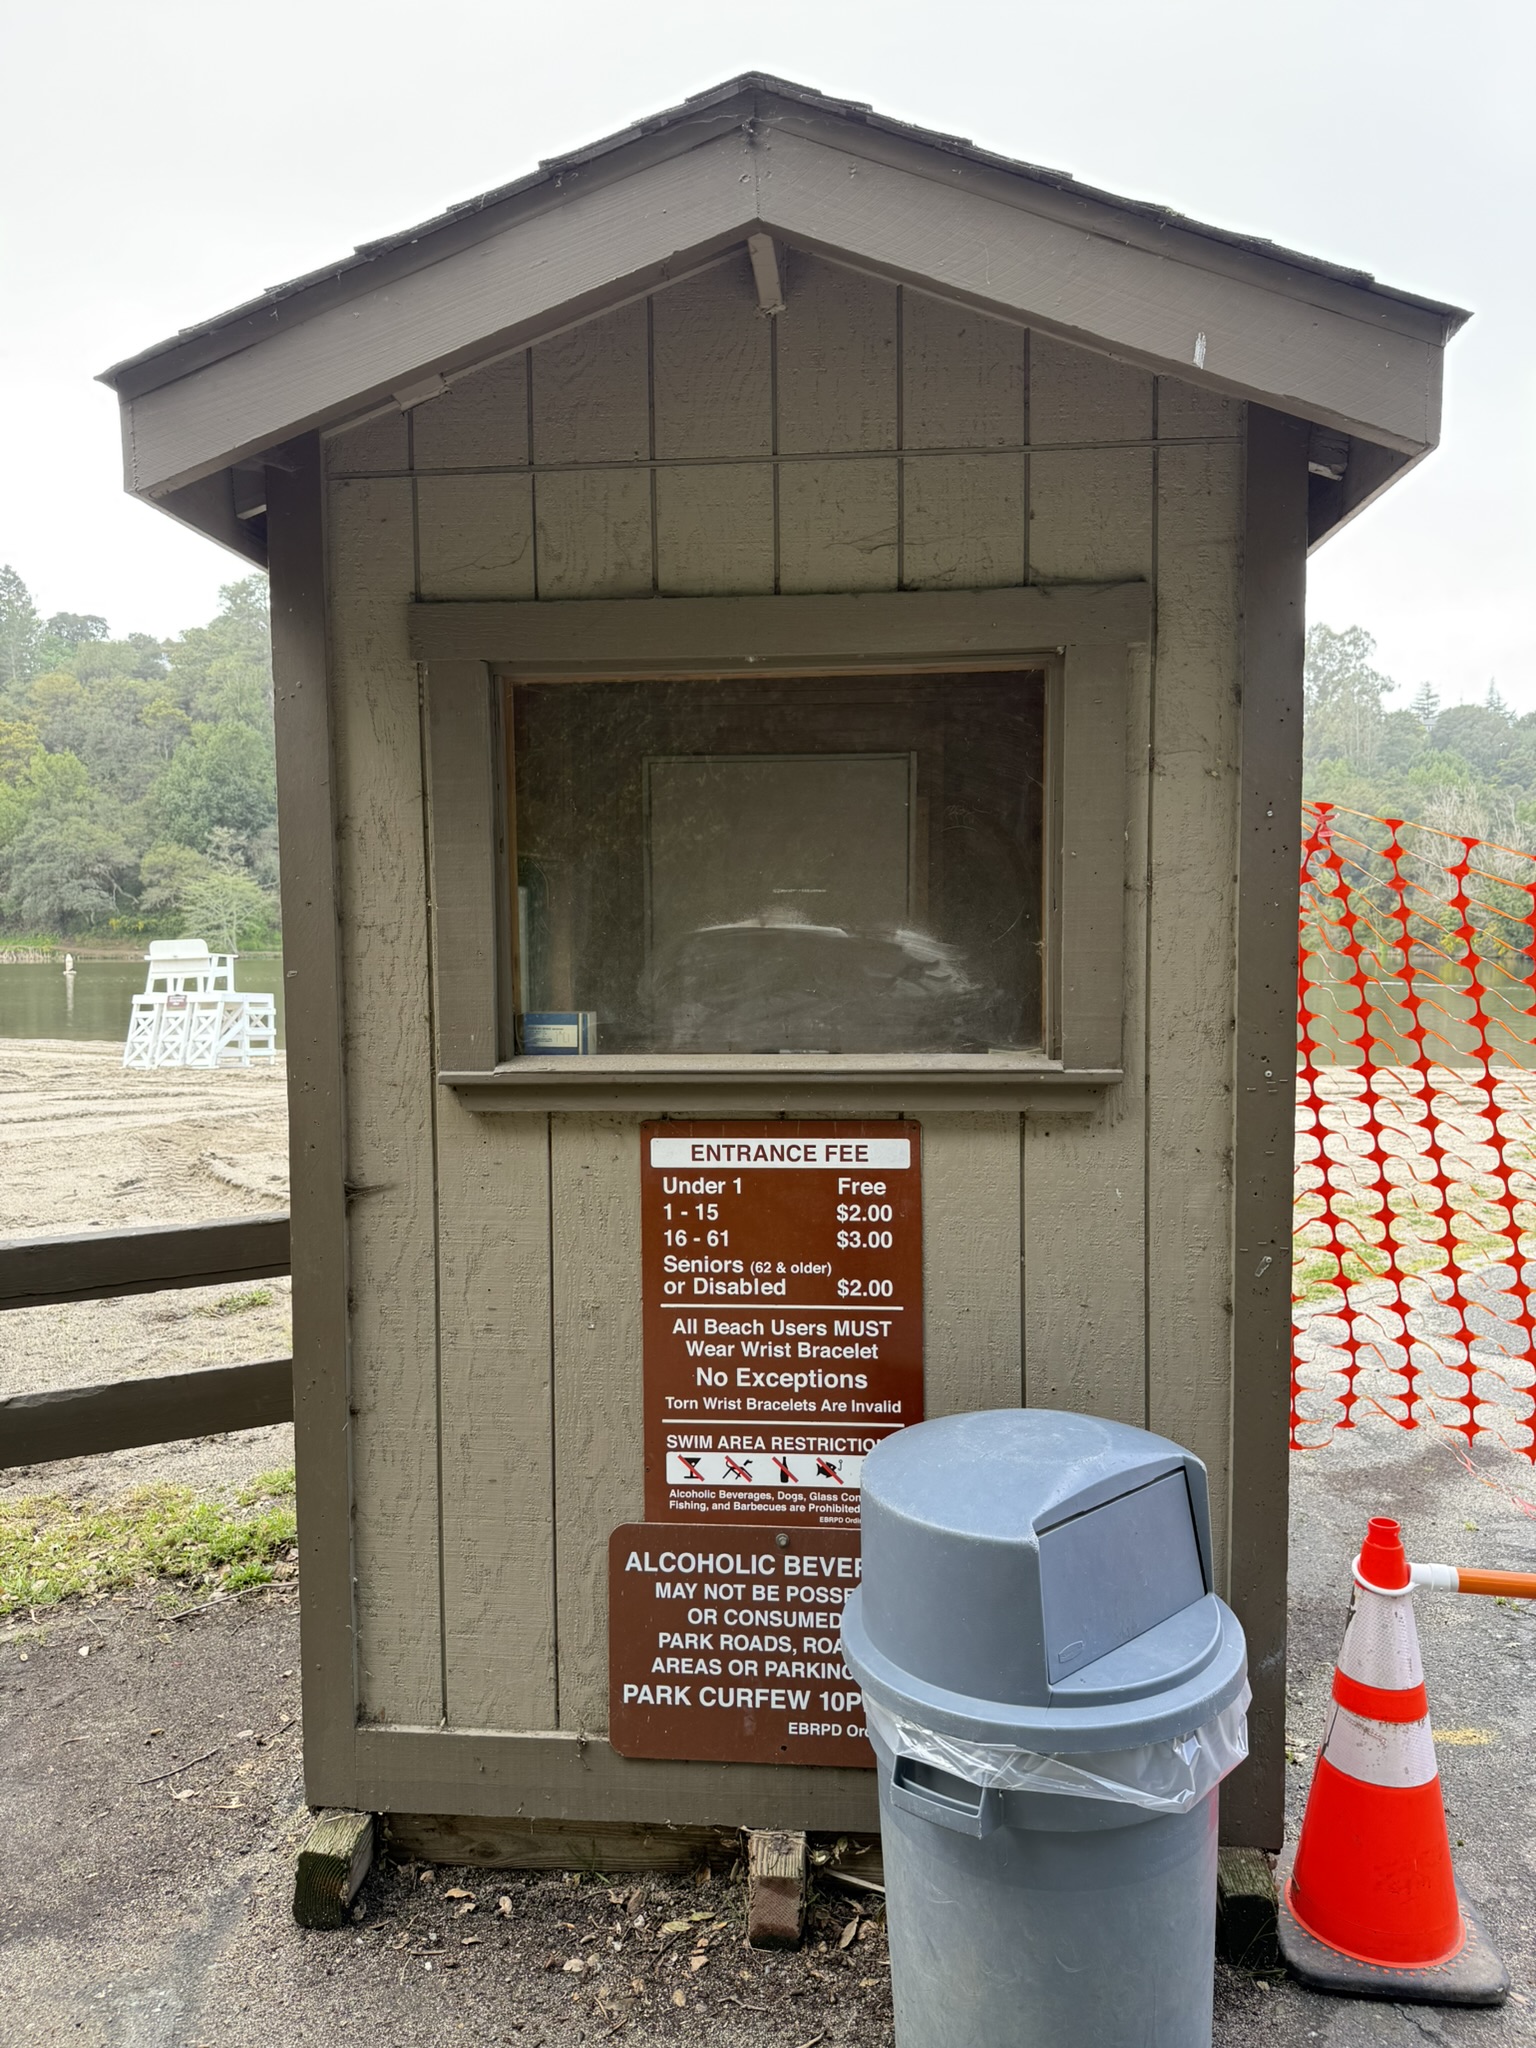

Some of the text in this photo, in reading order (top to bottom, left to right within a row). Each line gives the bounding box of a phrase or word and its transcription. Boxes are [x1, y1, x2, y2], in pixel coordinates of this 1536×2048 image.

[691, 1144, 869, 1163] ENTRANCE FEE
[663, 1176, 887, 1196] Under 1 Free
[663, 1203, 672, 1221] 1
[695, 1203, 719, 1221] 15
[836, 1202, 893, 1224] $2.00
[663, 1229, 688, 1247] 16
[706, 1229, 729, 1247] 61
[836, 1229, 893, 1250] $3.00
[663, 1254, 832, 1277] Seniors (62 & older)
[663, 1277, 894, 1299] or Disabled $2.00
[672, 1318, 893, 1337] All Beach Users MUST
[685, 1340, 879, 1360] Wear Wrist Bracelet
[696, 1366, 868, 1393] No Exceptions
[664, 1396, 902, 1414] Torn Wrist Bracelets Are Invalid
[666, 1434, 881, 1452] SWIM AREA RESTRICTIO
[669, 1488, 716, 1500] Alcoholic
[718, 1489, 775, 1502] Beverages,
[777, 1490, 807, 1503] Dogs,
[809, 1491, 839, 1503] Glass
[669, 1500, 860, 1514] Fishing, and Barbecues are Prohibited
[819, 1516, 844, 1524] EBRPD
[624, 1551, 776, 1576] ALCOHOLIC
[655, 1581, 698, 1600] MAY
[704, 1583, 747, 1601] NOT
[752, 1584, 780, 1602] BE
[687, 1607, 842, 1630] OR CONSUMED
[658, 1632, 714, 1650] PARK
[720, 1633, 797, 1656] ROADS,
[651, 1656, 722, 1676] AREAS
[728, 1659, 758, 1677] OR
[623, 1683, 692, 1706] PARK
[699, 1686, 811, 1710] CURFEW
[788, 1721, 843, 1737] EBRPD
